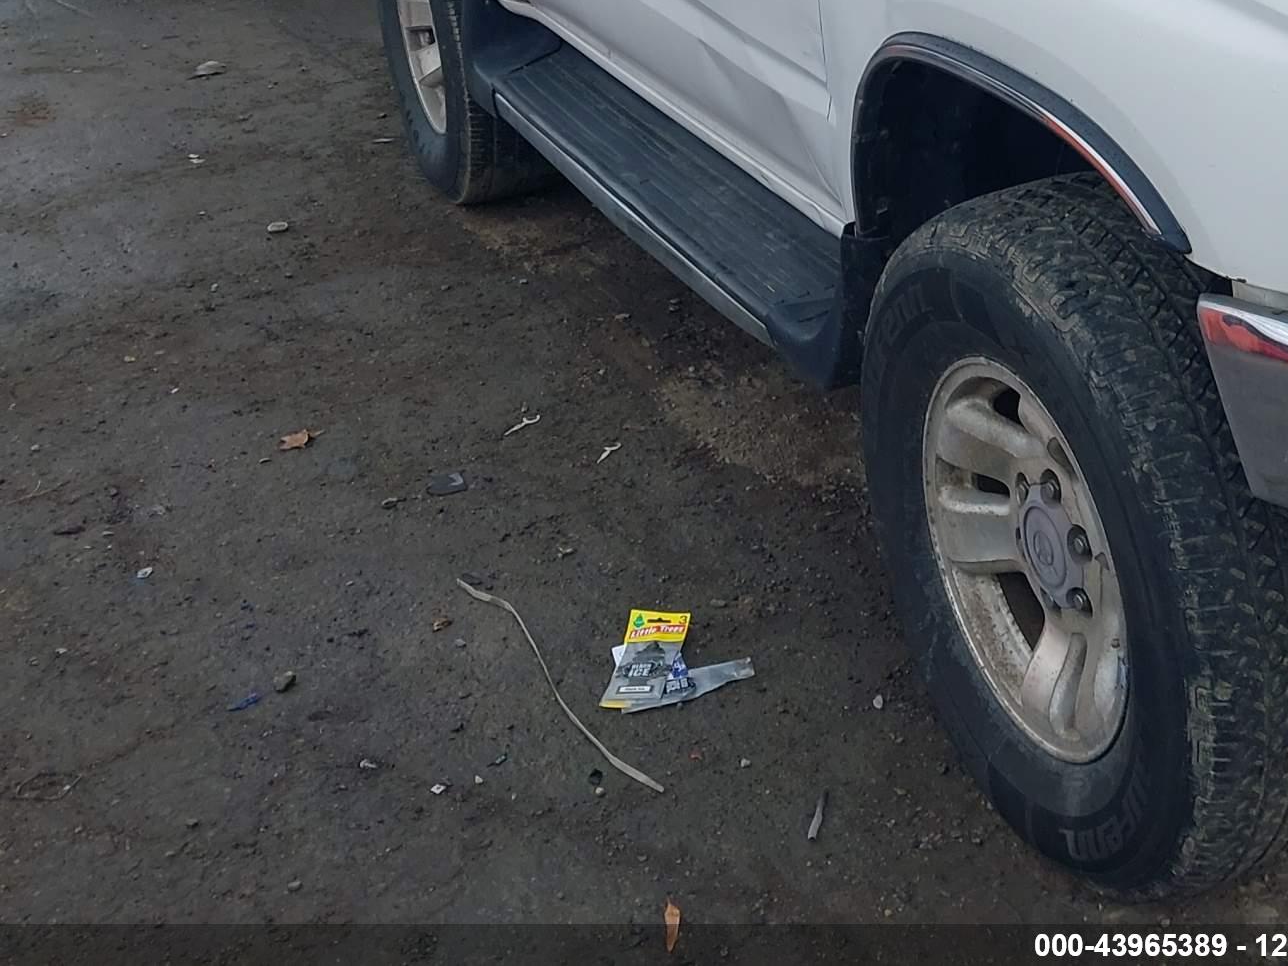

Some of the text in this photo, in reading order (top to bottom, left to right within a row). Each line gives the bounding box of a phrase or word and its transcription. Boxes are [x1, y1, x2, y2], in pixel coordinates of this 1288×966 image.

[679, 616, 688, 624] 3
[630, 625, 684, 639] Little Trees
[628, 669, 651, 677] ICE
